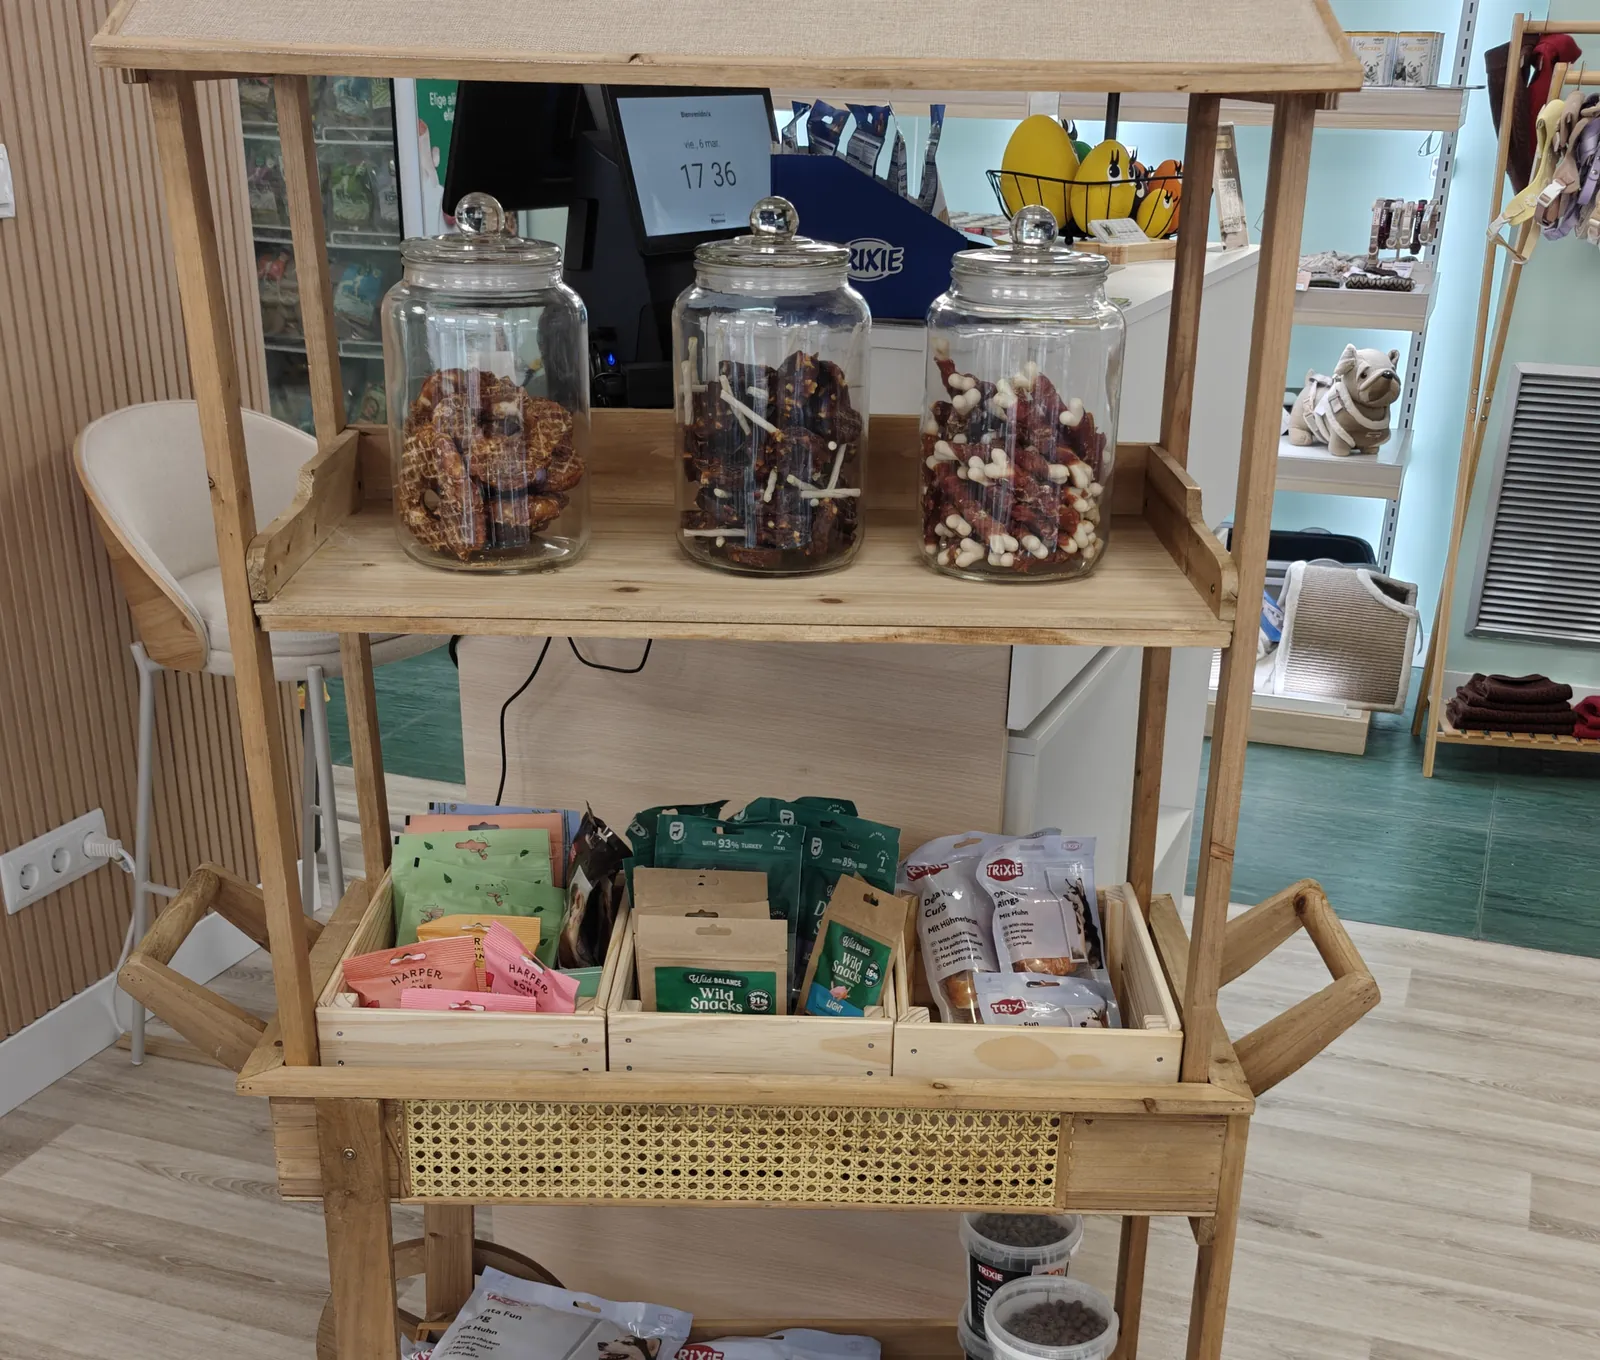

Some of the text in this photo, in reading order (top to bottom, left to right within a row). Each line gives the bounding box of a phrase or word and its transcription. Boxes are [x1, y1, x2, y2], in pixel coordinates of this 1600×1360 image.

[699, 139, 704, 149] 6
[680, 161, 737, 190] 17 36
[848, 247, 904, 272] RIXIE
[718, 838, 740, 849] 93%
[741, 842, 763, 850] TURKEY
[777, 834, 785, 845] 7
[880, 856, 886, 867] 7
[997, 897, 1019, 909] Rings
[1011, 909, 1029, 917] Huhn
[927, 923, 940, 934] Mit
[855, 943, 871, 957] BALANCE
[842, 952, 863, 971] Wild
[390, 968, 443, 986] HARPER
[509, 963, 548, 994] HARPER
[832, 960, 862, 984] Snacks
[688, 974, 742, 987] Wild BALANCE
[513, 980, 539, 997] BONE
[699, 987, 734, 1001] Wild
[690, 996, 743, 1013] Snacks
[750, 997, 768, 1005] 91%
[826, 999, 844, 1013] LIGHT
[503, 1310, 523, 1321] Fun
[473, 1325, 498, 1336] Huhn
